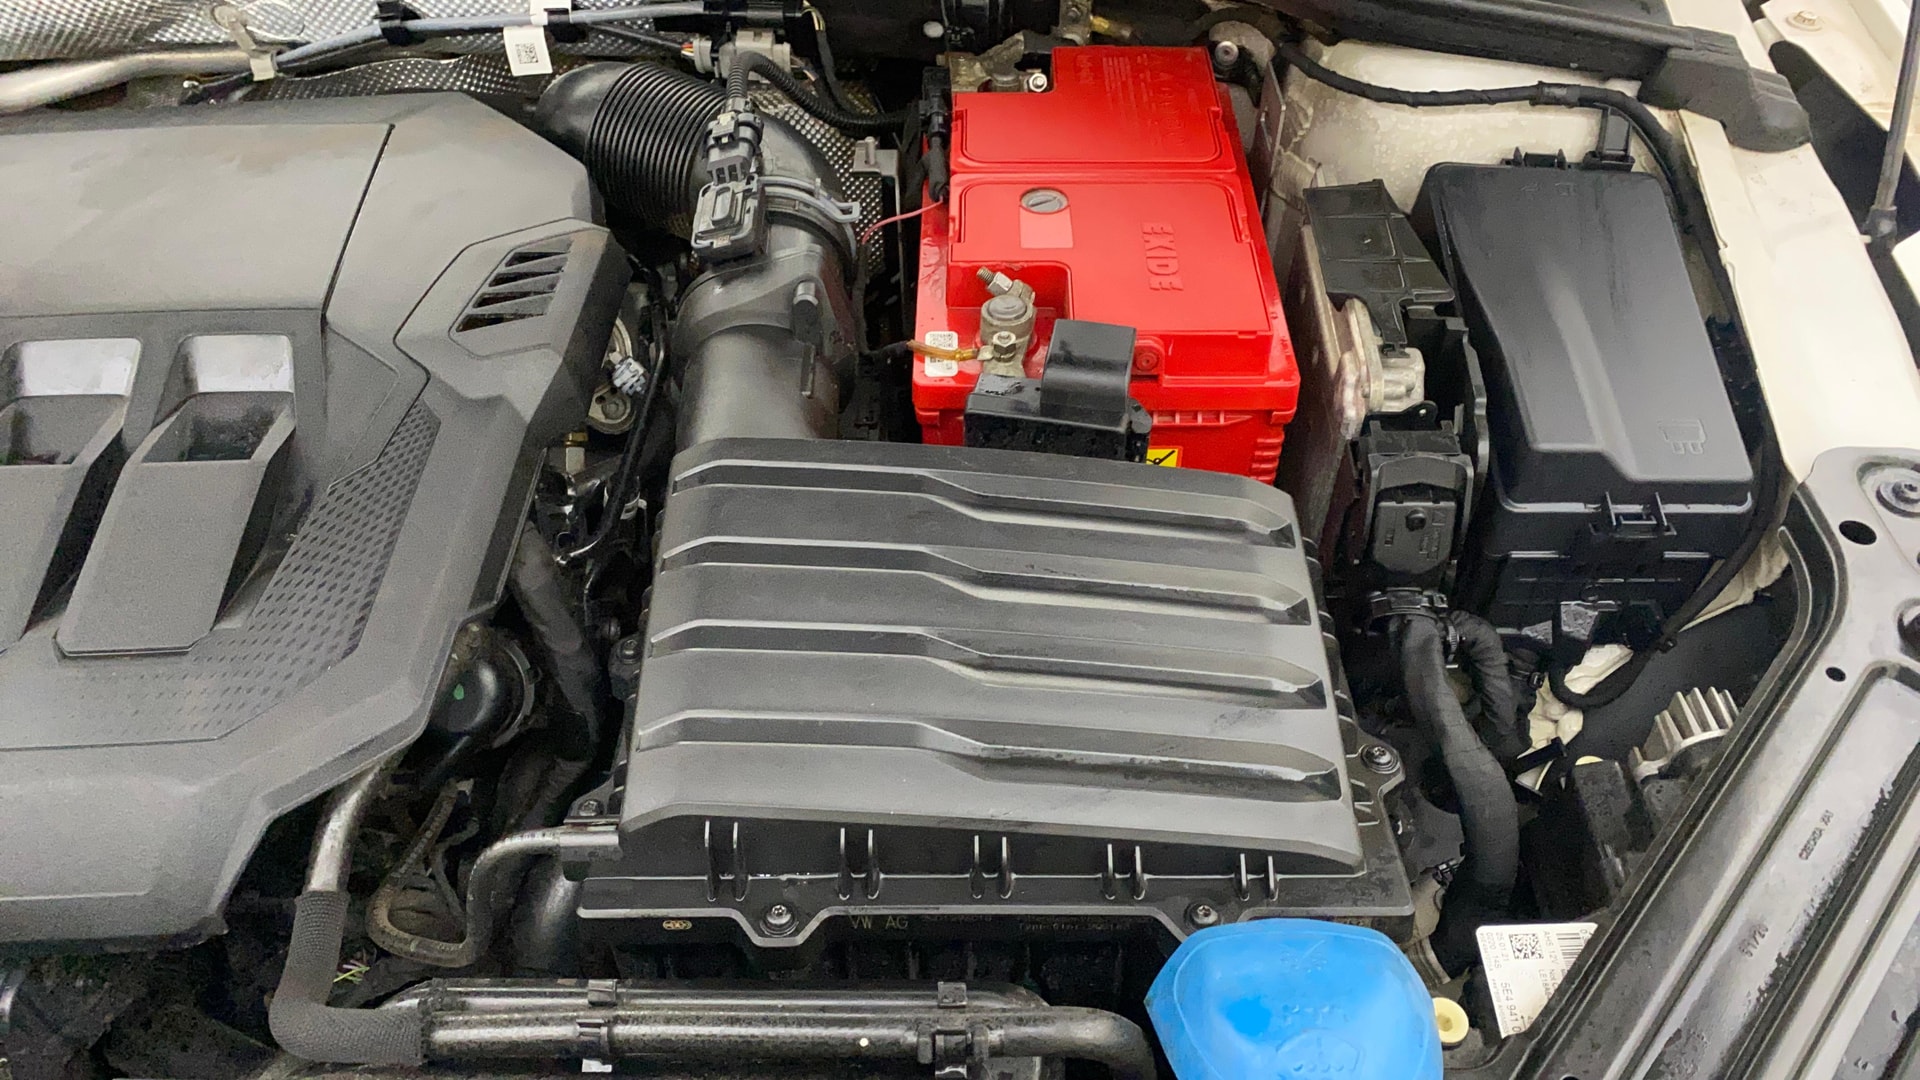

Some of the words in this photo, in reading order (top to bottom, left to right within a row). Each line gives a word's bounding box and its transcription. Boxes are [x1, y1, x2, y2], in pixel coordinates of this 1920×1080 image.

[848, 915, 872, 929] VW
[885, 915, 908, 929] AG
[1506, 1004, 1518, 1022] 941
